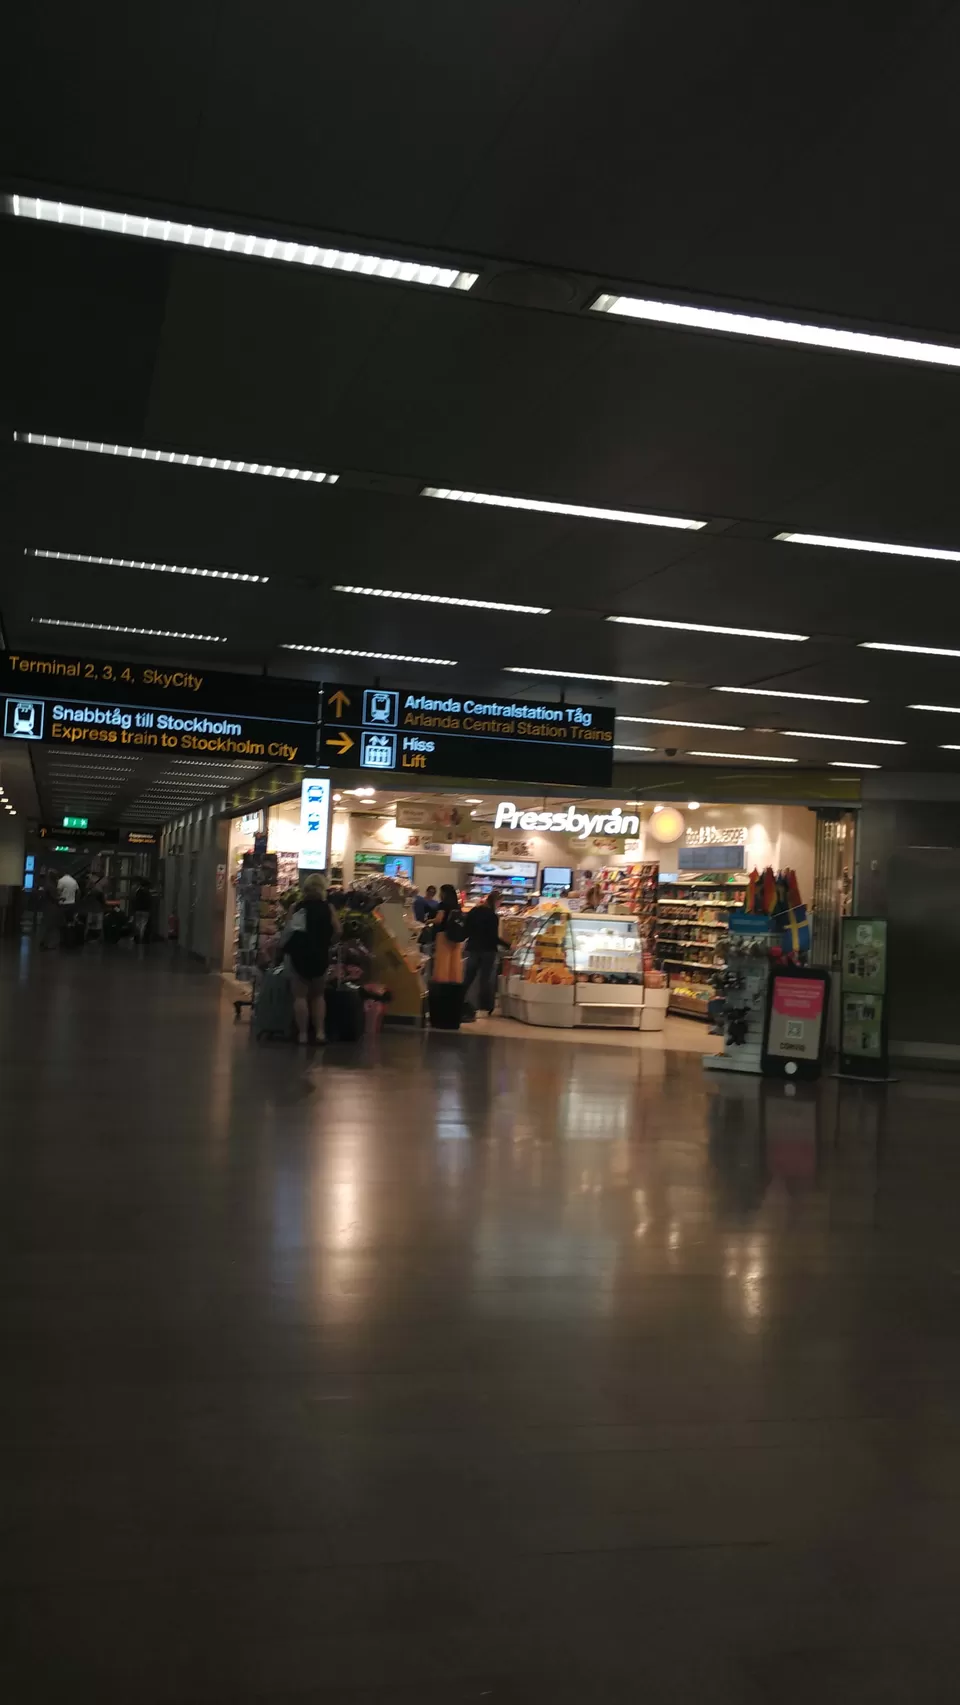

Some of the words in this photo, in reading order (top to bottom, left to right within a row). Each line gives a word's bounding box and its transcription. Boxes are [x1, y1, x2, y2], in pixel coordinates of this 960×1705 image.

[9, 655, 80, 677] Terminal
[84, 663, 98, 680] 2,
[103, 665, 117, 682] 3,
[120, 667, 135, 684] 4,
[142, 669, 203, 692] SkyCity
[52, 704, 132, 730] Snabbtåg
[135, 713, 154, 729] till
[157, 715, 242, 736] Stockholm
[404, 694, 461, 713] Arlanda
[464, 699, 563, 722] Centralstation
[566, 707, 593, 727] Tåg
[404, 711, 460, 729] Arlanda
[462, 717, 514, 734] Central
[517, 721, 568, 738] Station
[571, 725, 613, 742] Trains
[51, 723, 117, 744] Express
[121, 729, 158, 747] train
[161, 732, 177, 748] to
[180, 734, 264, 756] Stockholm
[268, 741, 299, 760] City
[402, 736, 435, 752] Hiss
[402, 753, 427, 768] Lift
[494, 802, 640, 840] Pressbyrån
